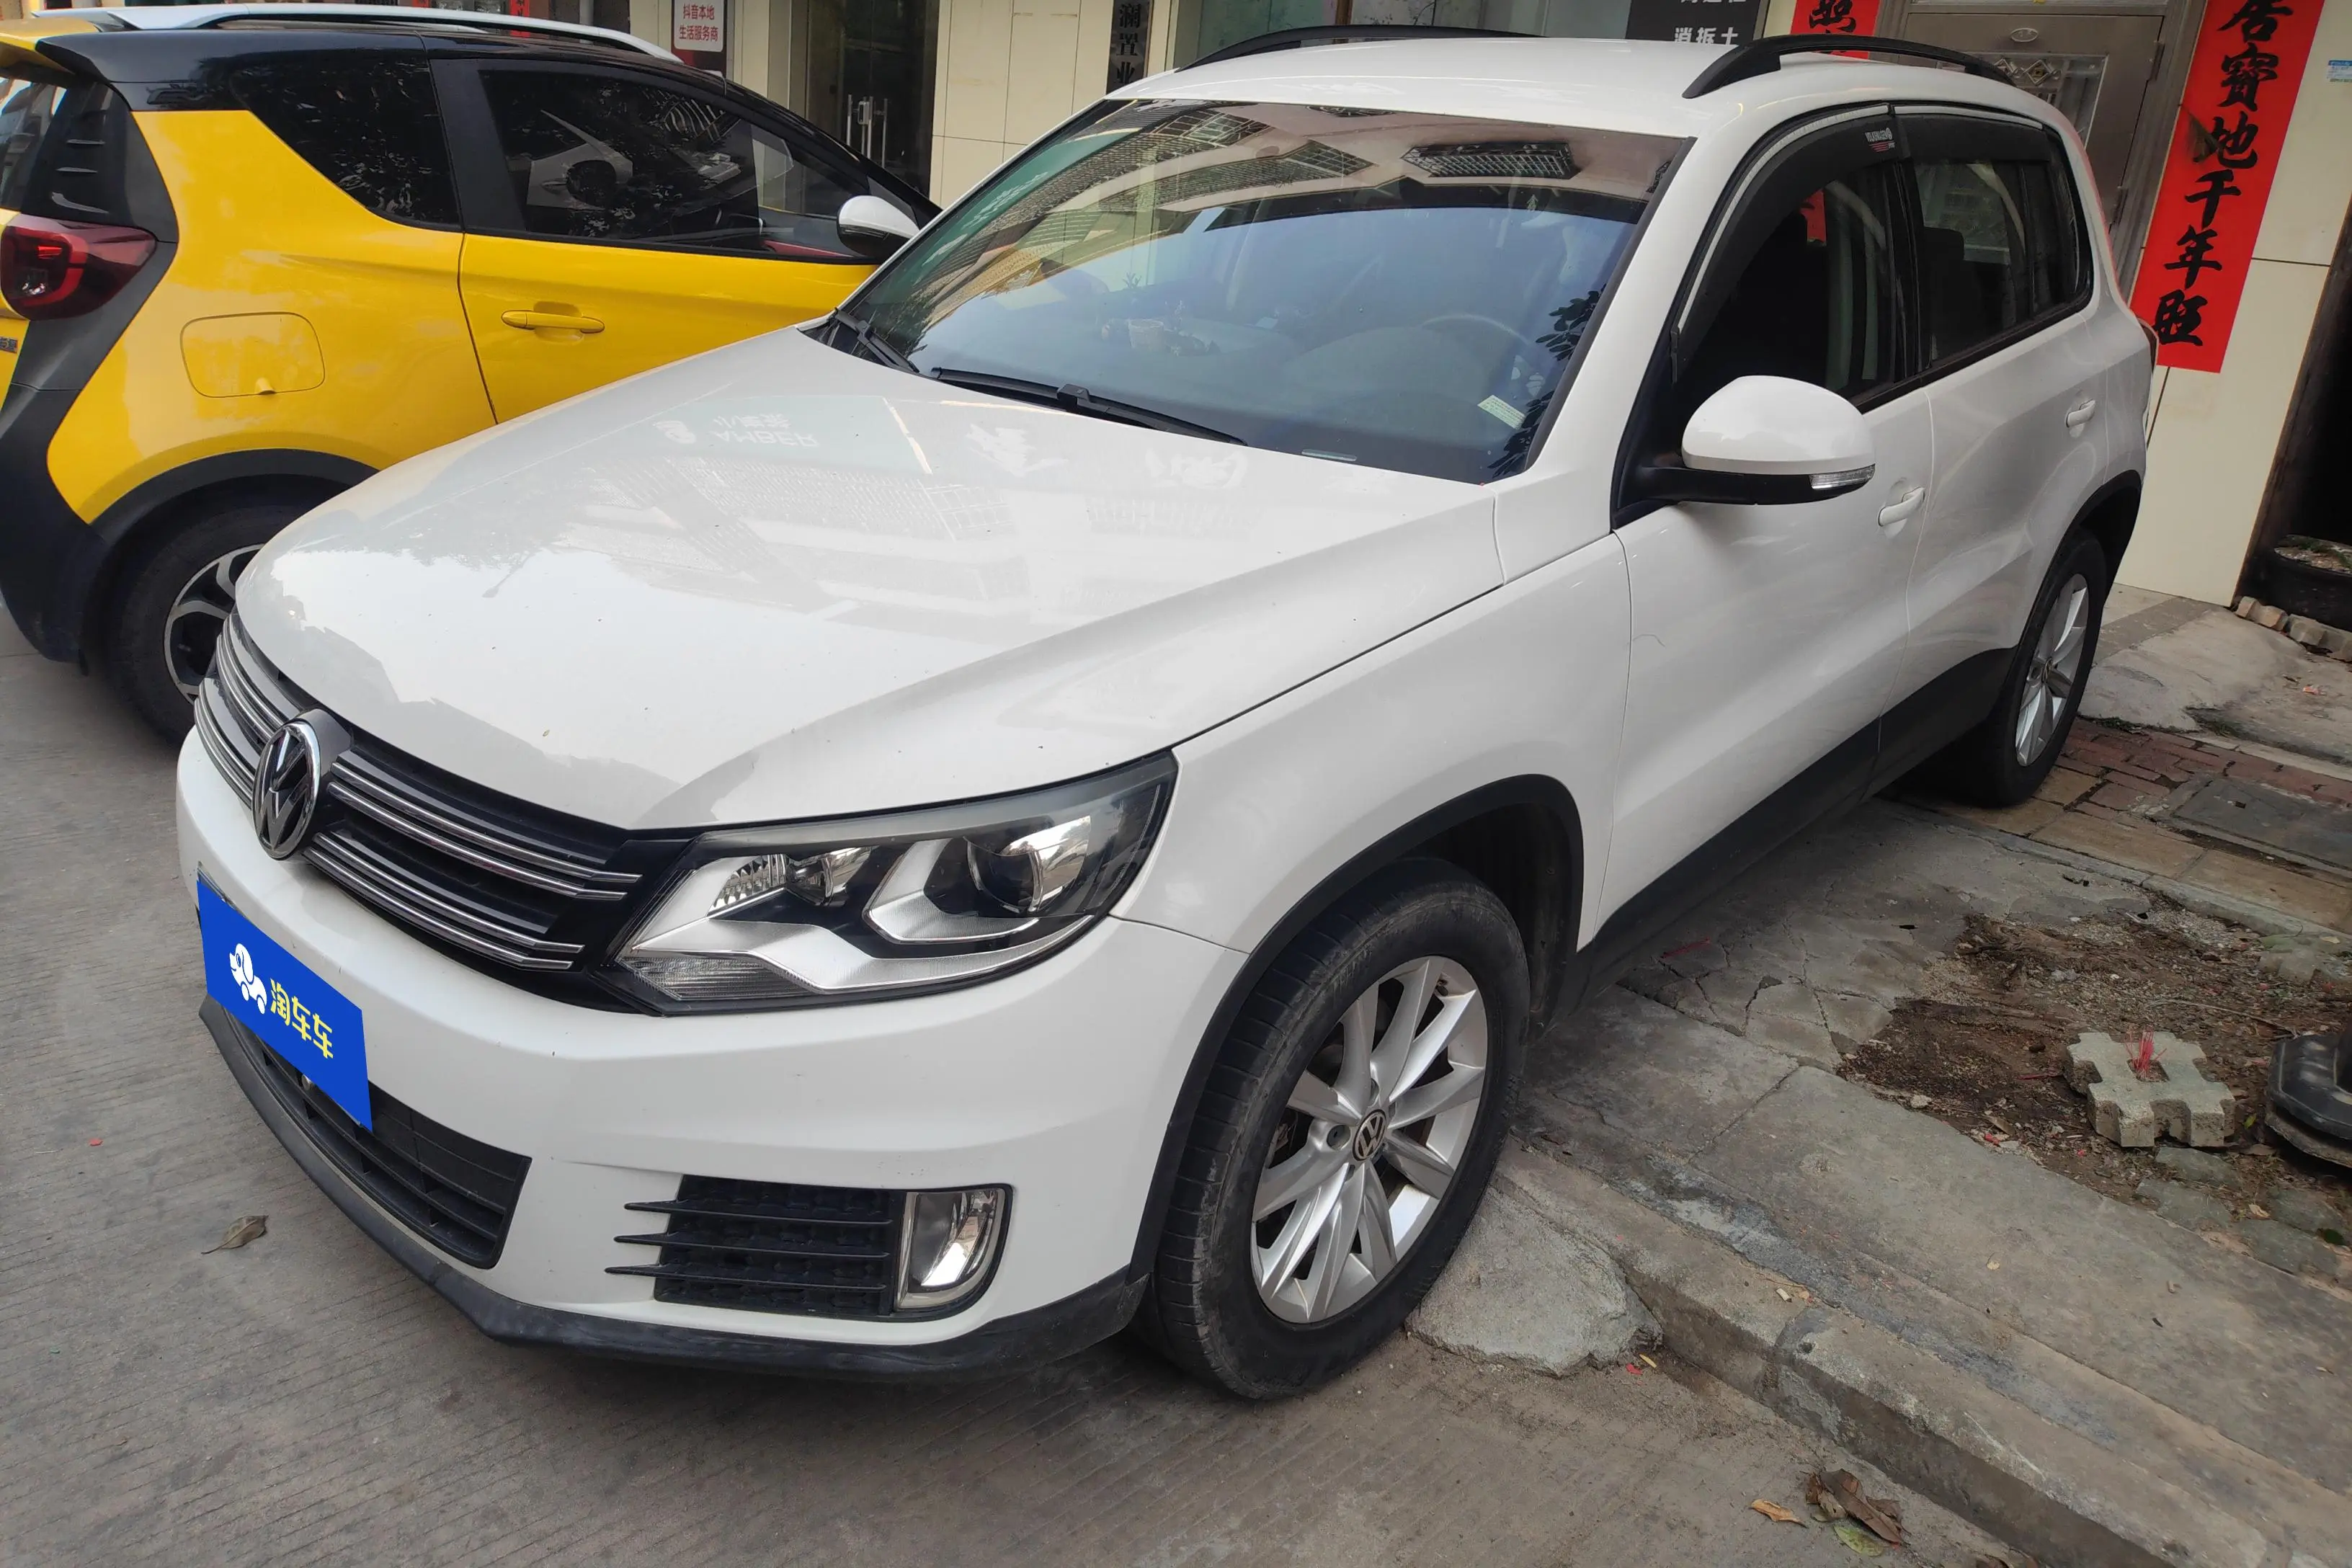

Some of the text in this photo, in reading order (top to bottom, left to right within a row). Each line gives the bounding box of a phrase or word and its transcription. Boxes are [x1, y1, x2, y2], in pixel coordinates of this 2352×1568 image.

[682, 3, 715, 20] 抖音本地
[679, 24, 718, 42] 生活服务商
